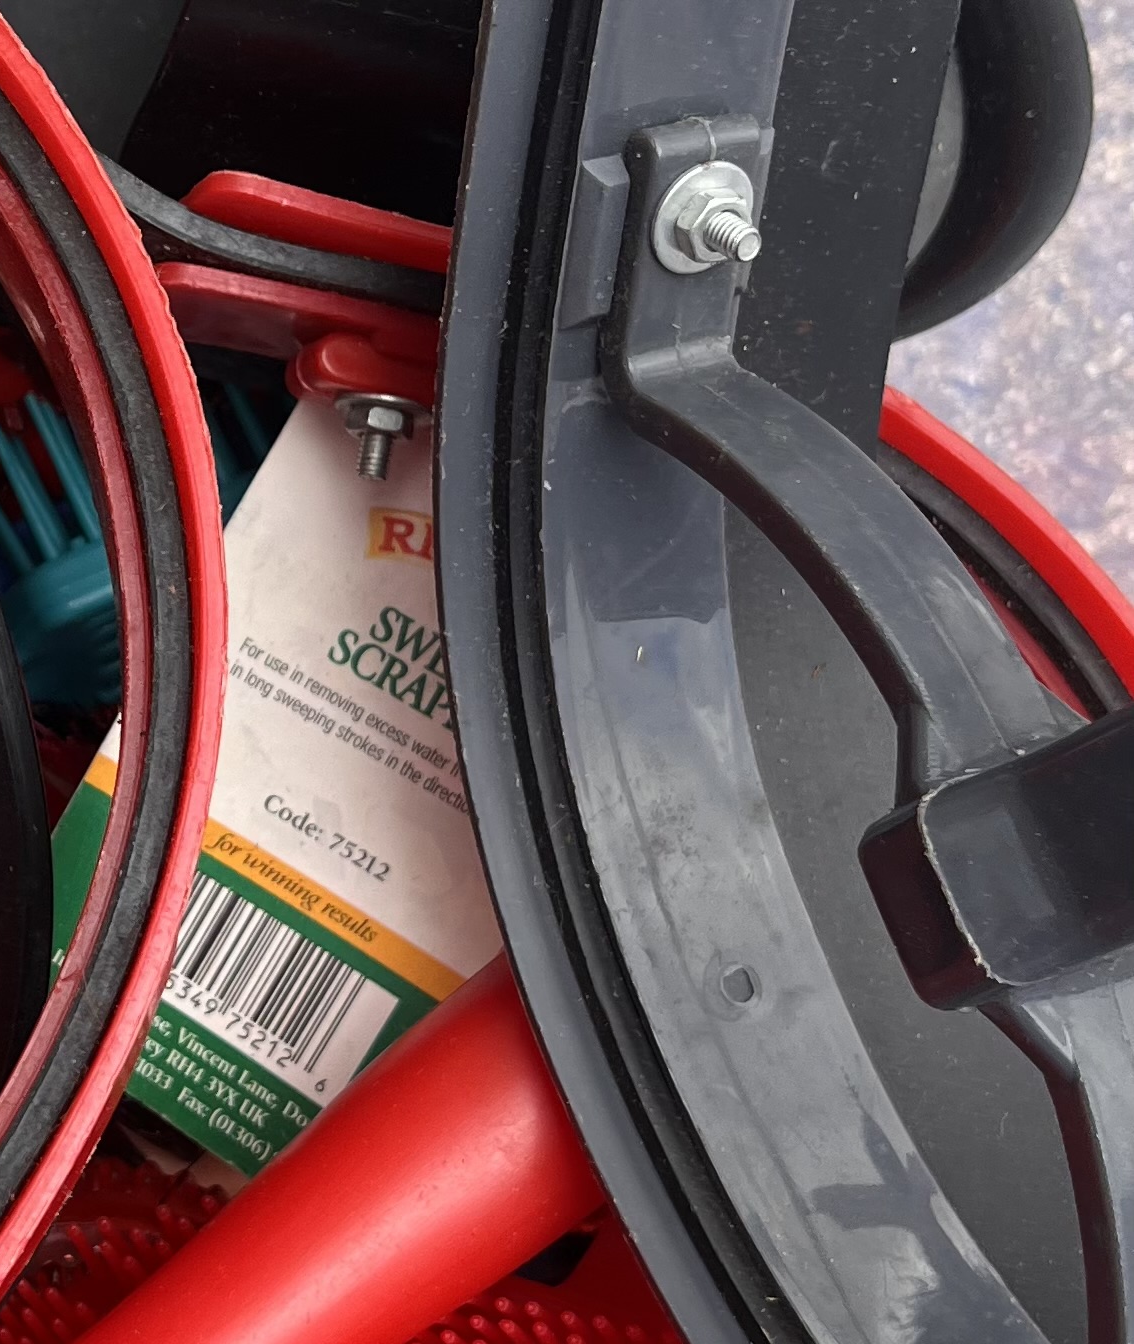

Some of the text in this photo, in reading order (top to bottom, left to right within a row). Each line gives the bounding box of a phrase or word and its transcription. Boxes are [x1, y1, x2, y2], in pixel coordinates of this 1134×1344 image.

[239, 636, 265, 660] For
[264, 653, 289, 676] use
[288, 664, 304, 684] in
[303, 677, 365, 722] removing
[365, 713, 410, 747] excess
[410, 739, 451, 770] water
[328, 628, 456, 731] SCRAP
[229, 660, 243, 677] in
[243, 666, 274, 698] long
[273, 688, 337, 734] sweeping
[335, 721, 384, 762] strokes
[384, 753, 398, 770] in
[399, 759, 422, 784] the
[422, 775, 470, 816] directio
[204, 832, 380, 943] for winning results
[264, 794, 392, 882] Code: 75212
[165, 973, 327, 1093] 5349 75212 6
[177, 1026, 239, 1079] Vincent
[238, 1069, 280, 1110] Lane,
[282, 1100, 311, 1128] Do
[135, 1058, 274, 1161] 1033 Fax: (01306)
[166, 1048, 206, 1084] RH4
[204, 1076, 241, 1107] 3YX
[239, 1099, 270, 1129] UK
